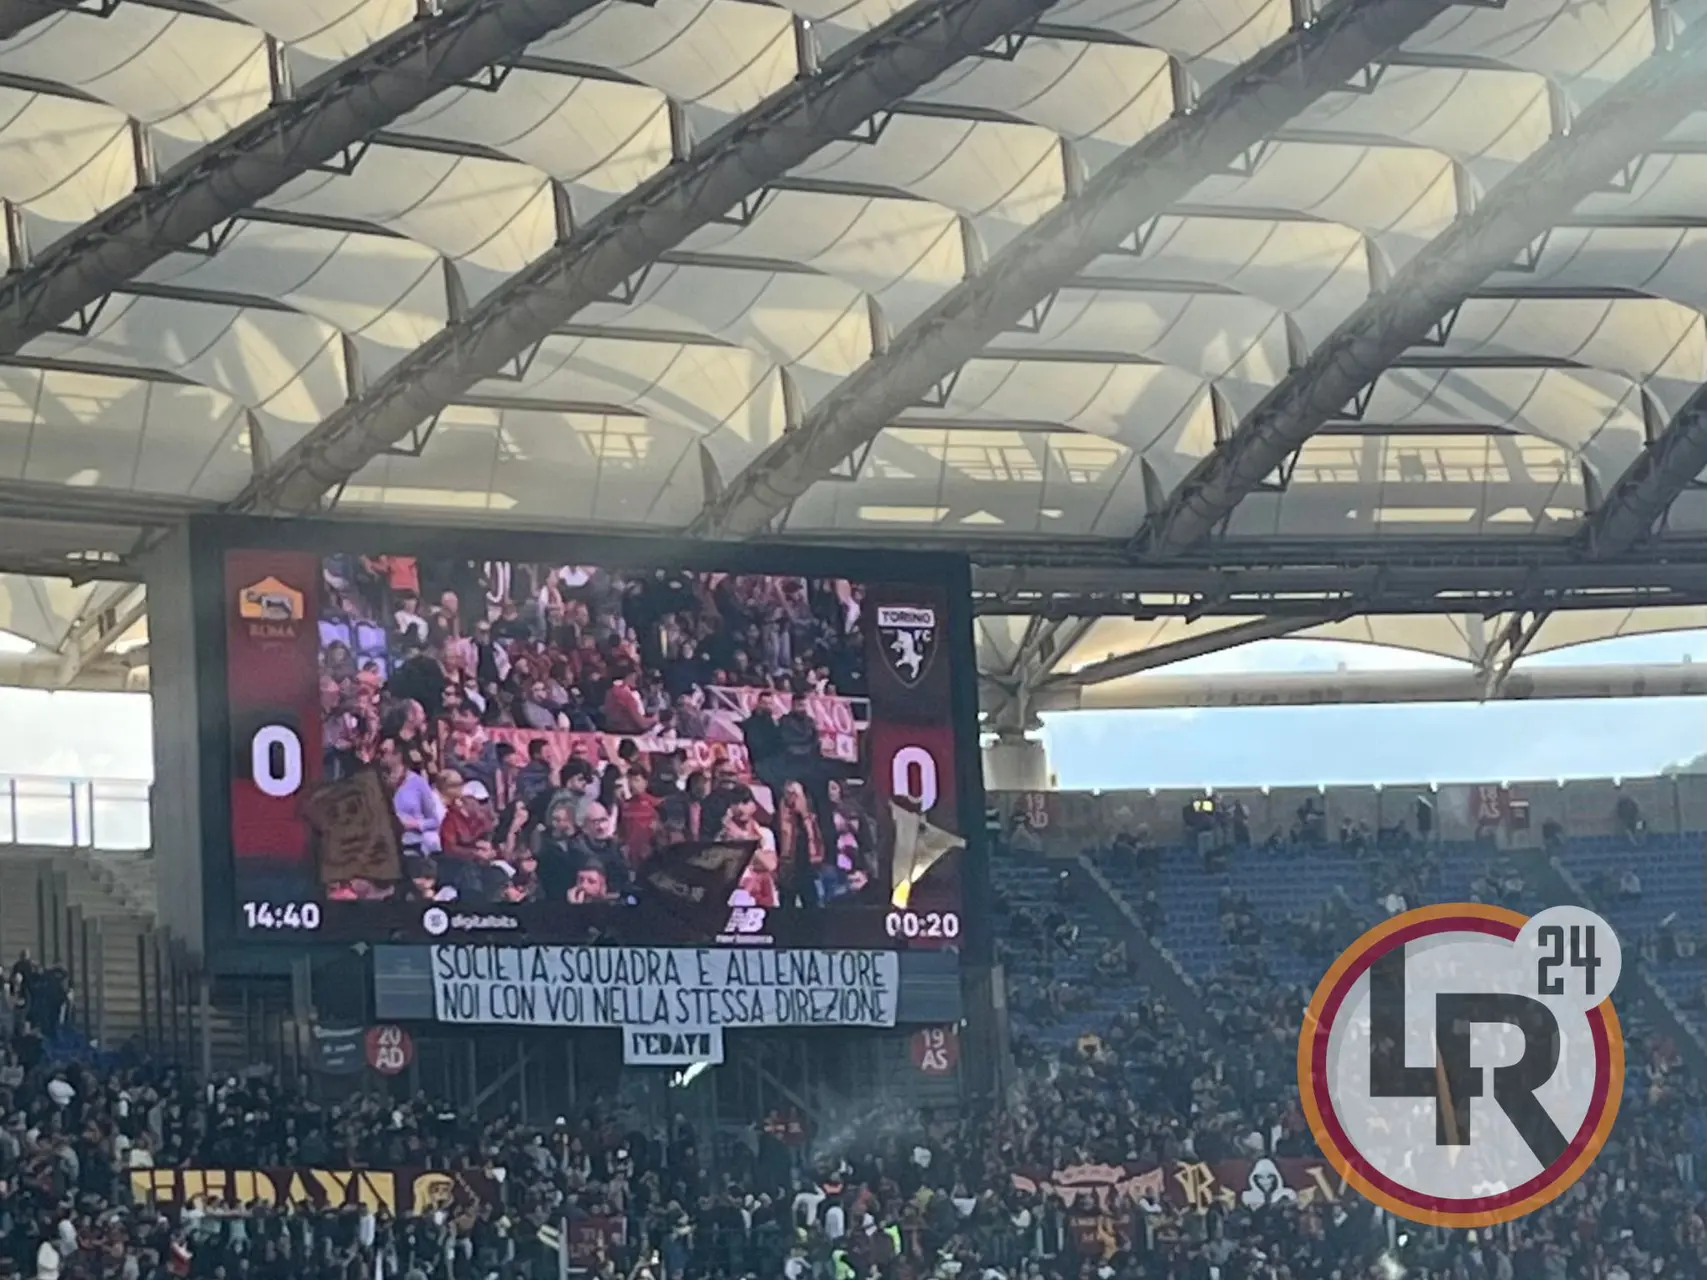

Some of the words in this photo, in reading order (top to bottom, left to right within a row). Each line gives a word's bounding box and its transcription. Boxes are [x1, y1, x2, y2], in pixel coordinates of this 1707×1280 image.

[882, 611, 931, 624] TORINO
[251, 725, 302, 796] 0
[893, 747, 937, 812] 0
[243, 903, 321, 929] 14:40
[885, 913, 960, 937] 00:20
[560, 949, 682, 985] SQUADRA
[696, 950, 713, 985] E
[724, 951, 886, 987] ALLENATORE
[443, 983, 479, 1019] NOI
[489, 985, 535, 1021] CON
[546, 986, 585, 1022] VOI
[593, 987, 669, 1025] NELLA
[675, 988, 764, 1024] STESSA
[774, 989, 889, 1023] DIREZIONE
[921, 1029, 943, 1048] 19
[376, 1046, 404, 1069] AD
[921, 1050, 948, 1070] AS
[130, 1168, 396, 1218] FEDAYN
